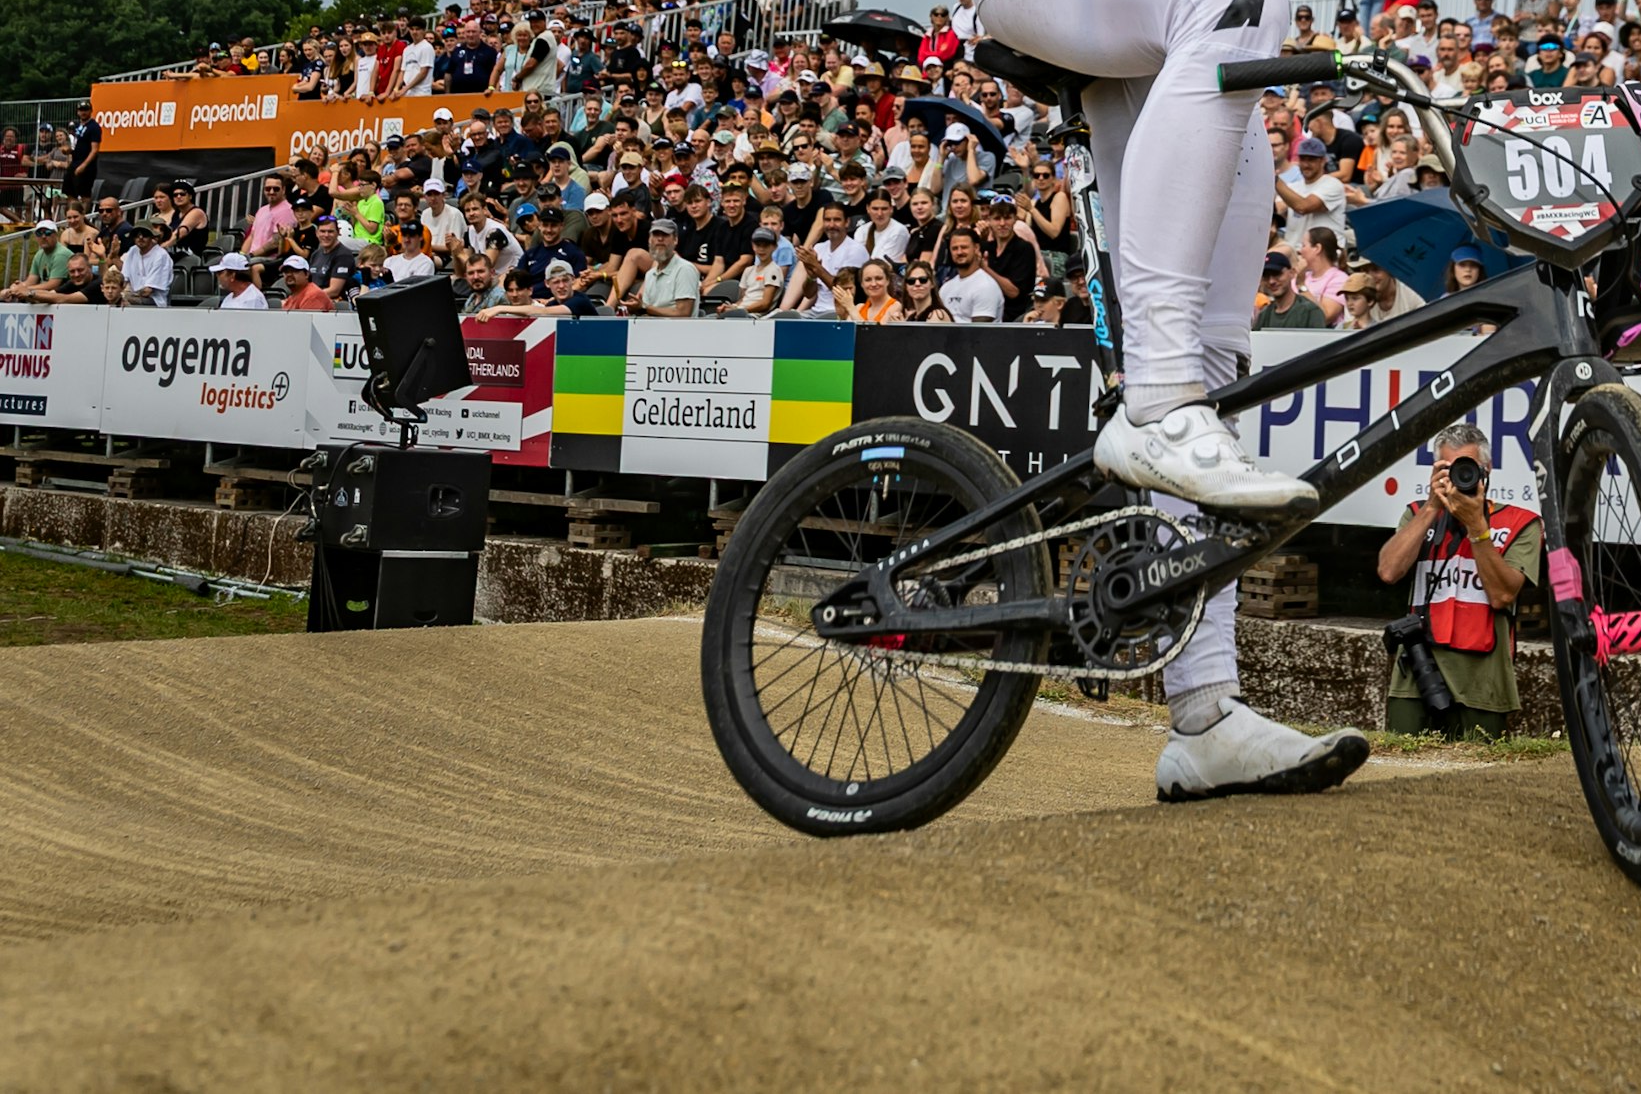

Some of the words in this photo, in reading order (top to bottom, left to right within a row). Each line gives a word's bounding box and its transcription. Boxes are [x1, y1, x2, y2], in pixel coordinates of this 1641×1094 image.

[190, 95, 262, 130] papendal
[1528, 89, 1565, 106] box
[1525, 116, 1547, 125] UCI
[1504, 134, 1613, 201] 504
[122, 335, 252, 387] oegema
[646, 359, 729, 391] provincie
[0, 396, 45, 412] ctures
[200, 381, 277, 414] logistics
[632, 397, 757, 430] Gelderland
[466, 431, 512, 443] UCI_BMX_Racing
[1168, 552, 1207, 578] box
